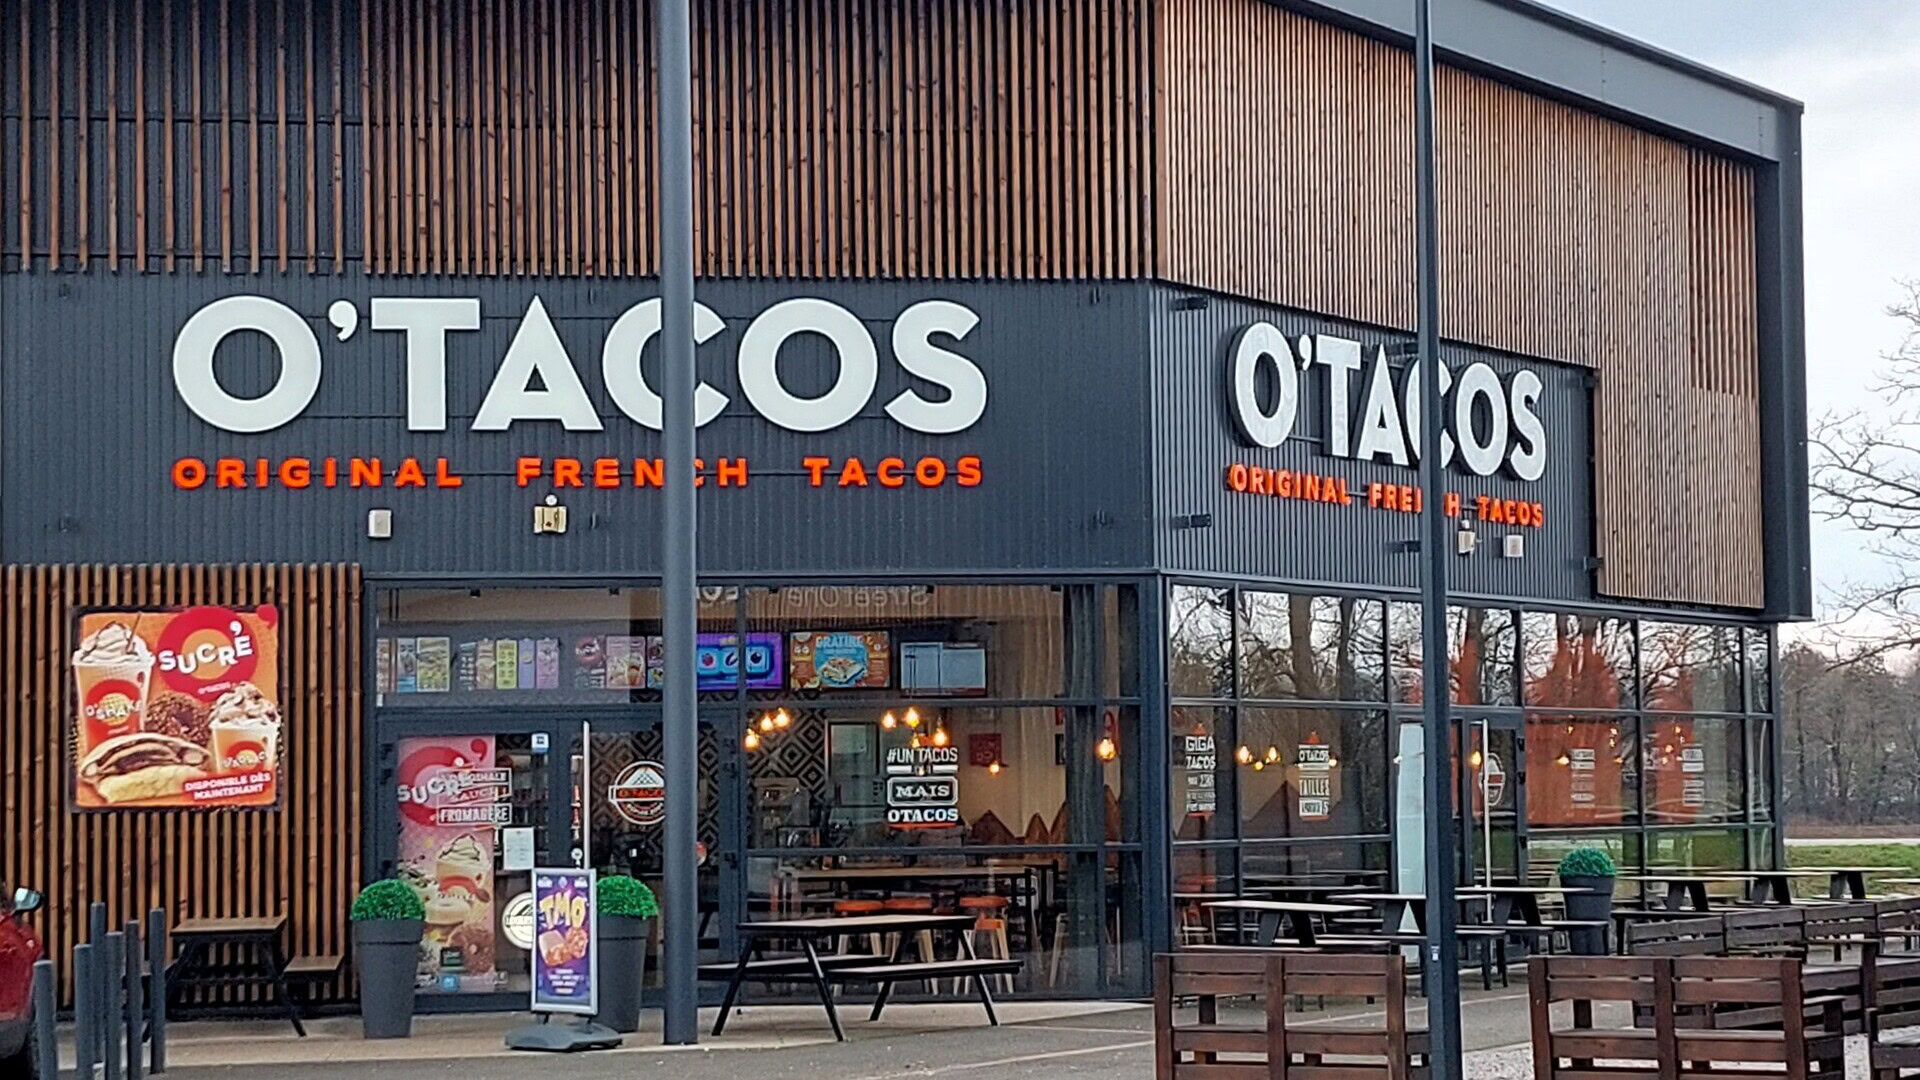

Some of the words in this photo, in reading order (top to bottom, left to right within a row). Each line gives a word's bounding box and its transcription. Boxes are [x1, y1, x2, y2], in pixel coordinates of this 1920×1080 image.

[172, 294, 988, 434] O'TACOS
[1231, 321, 1547, 482] O'TACOS
[172, 456, 464, 490] ORIGINAL
[803, 456, 983, 489] TACOS
[1228, 463, 1352, 506] ORIGINAL
[1368, 483, 1460, 517] FREH
[1477, 495, 1545, 528] TACOS
[1186, 735, 1215, 751] GIGA
[886, 748, 914, 763] #UN
[917, 747, 958, 763] TACOS
[895, 785, 950, 798] MAIS
[1299, 779, 1330, 796] TAILLES
[888, 808, 959, 823] OTACOS
